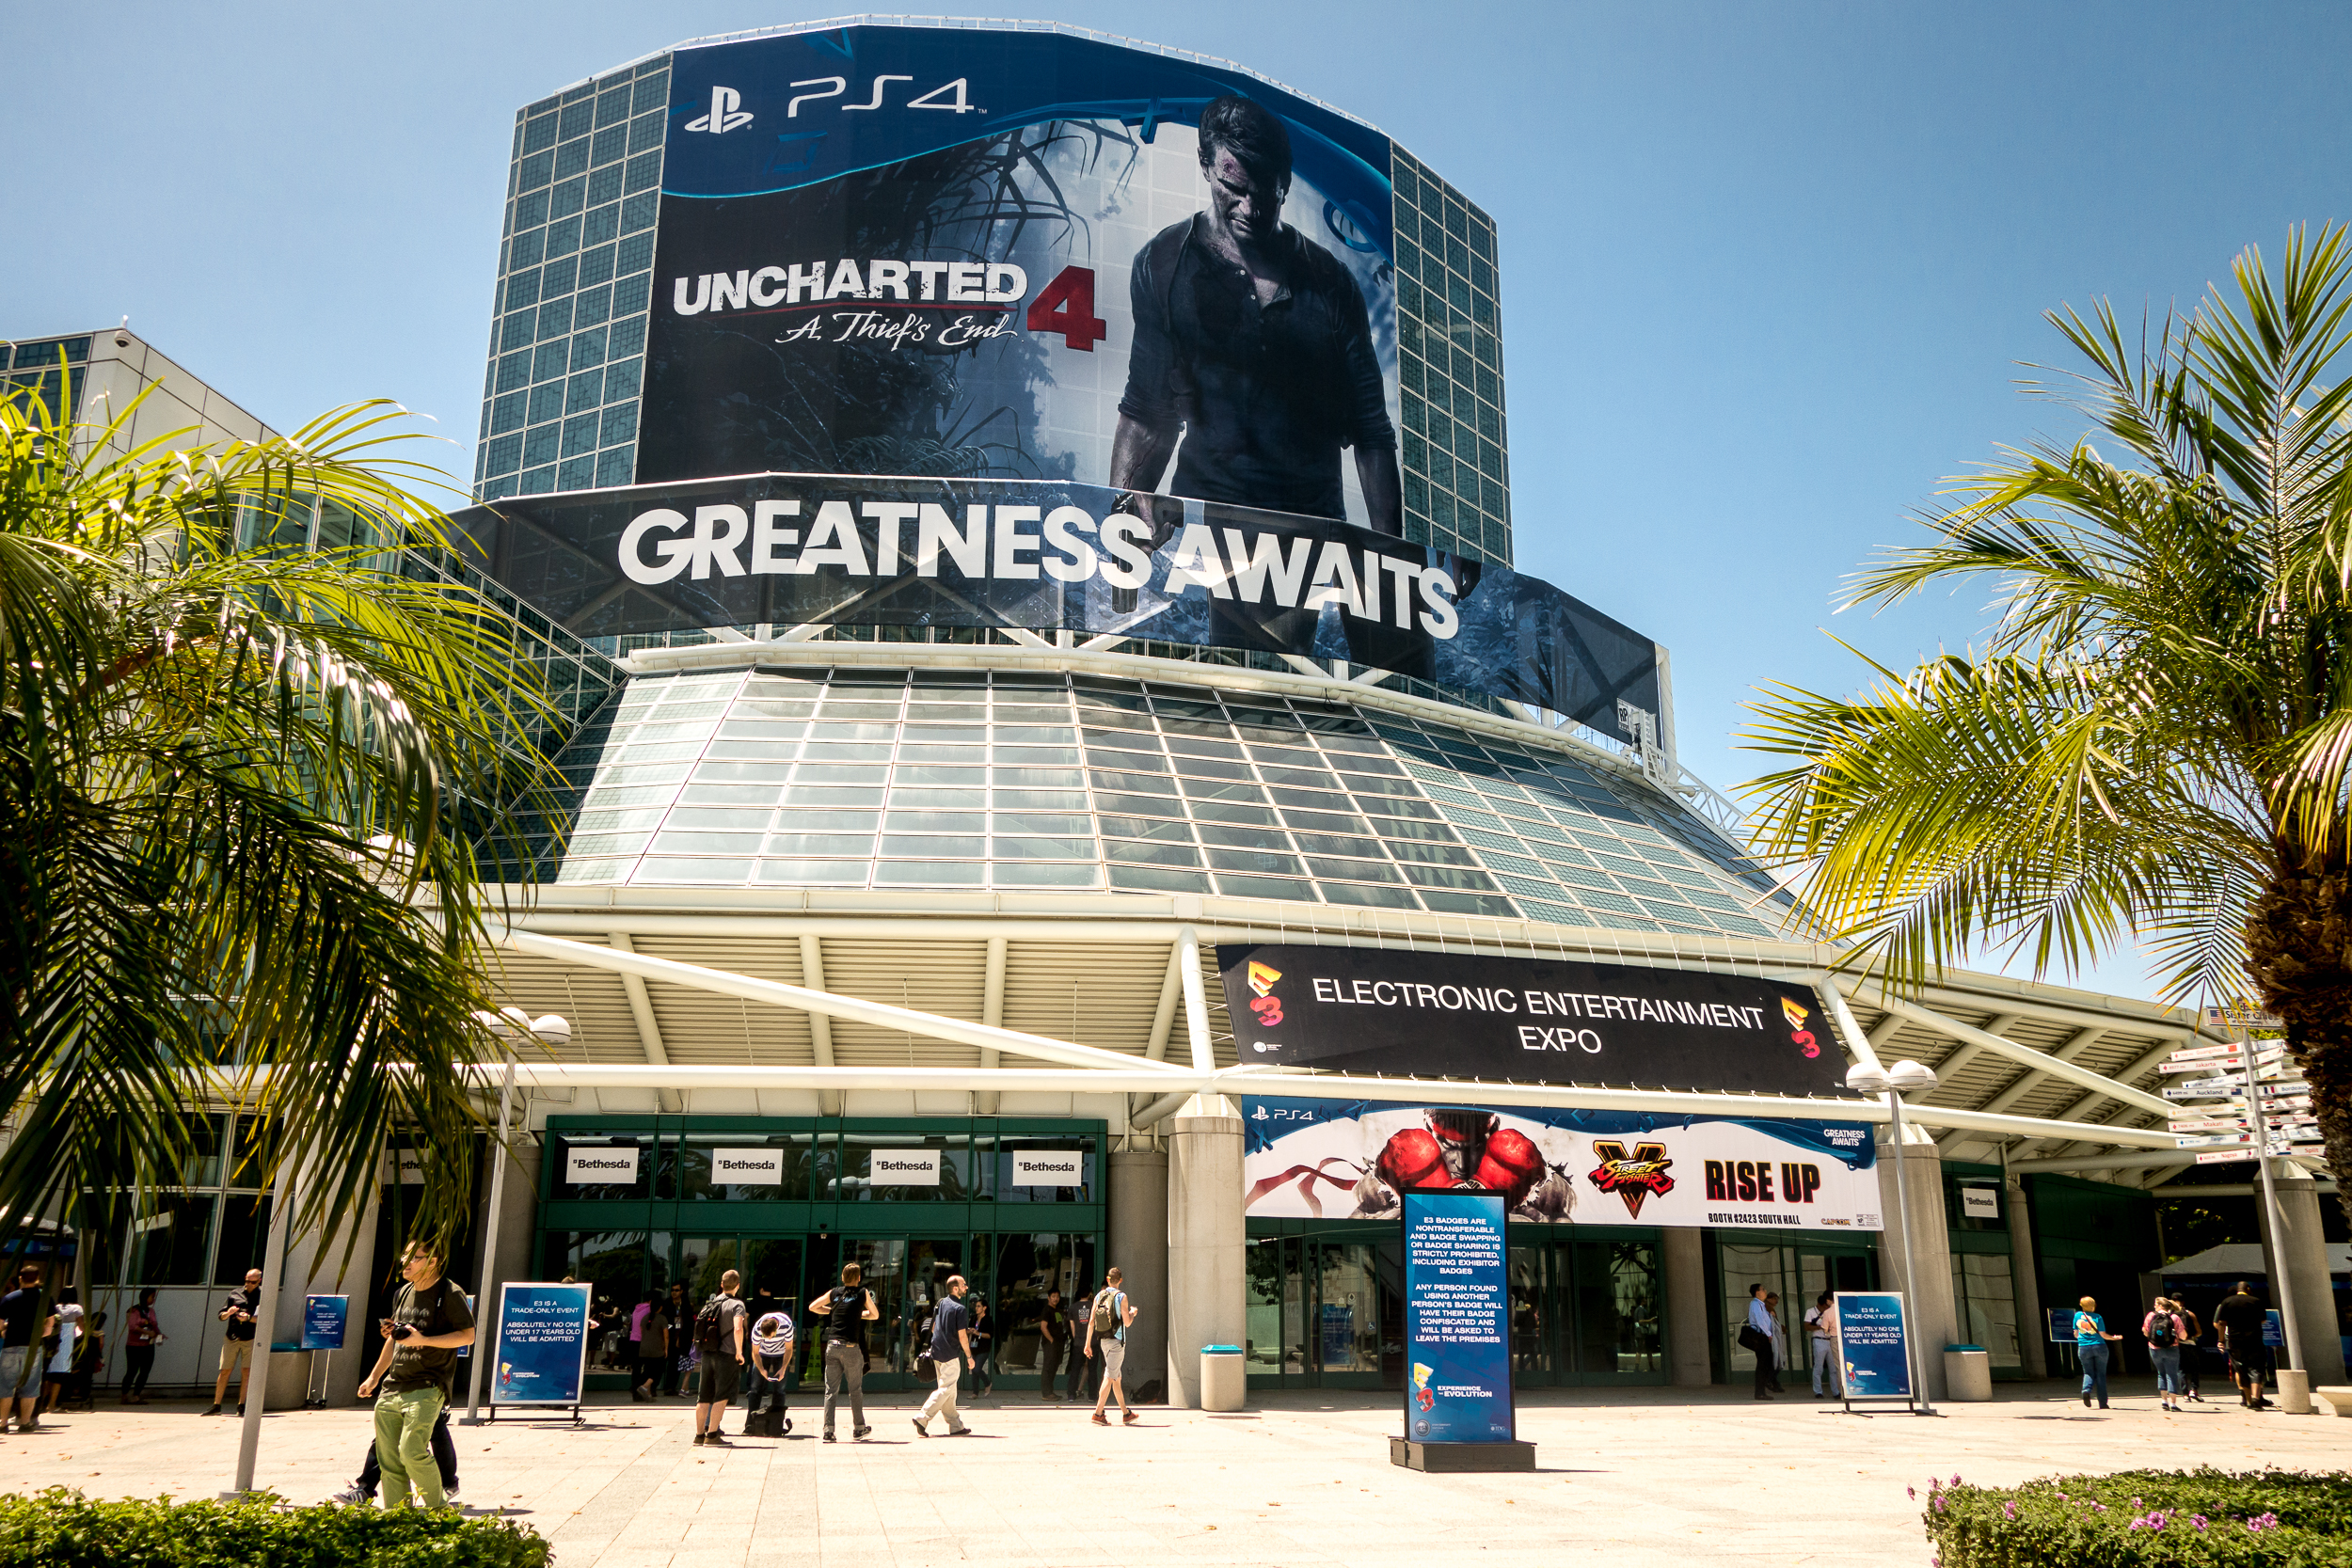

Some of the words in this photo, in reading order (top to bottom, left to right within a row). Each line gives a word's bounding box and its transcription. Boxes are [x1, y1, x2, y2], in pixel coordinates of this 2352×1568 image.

[787, 74, 975, 118] PS4
[674, 259, 1028, 315] UNCHARTED
[1027, 265, 1106, 352] 4
[775, 318, 821, 343] A
[833, 311, 931, 352] Thief's
[937, 313, 1018, 346] End
[617, 499, 1152, 590] GREATNESS
[1163, 523, 1458, 640] AWAITS
[1248, 960, 1284, 1027] E3
[1312, 977, 1518, 1013] ELECTRONIC
[1524, 990, 1764, 1030] ENTERTAINMENT
[1780, 996, 1820, 1059] E3
[1518, 1025, 1602, 1053] EXPO
[1274, 1109, 1313, 1120] PS4
[1823, 1128, 1865, 1139] GREATNESS
[1832, 1137, 1859, 1146] AWAITS
[578, 1159, 631, 1169] Bethesda
[723, 1160, 775, 1170] Bethesda
[881, 1161, 933, 1171] Bethesda
[1023, 1162, 1075, 1172] Bethesda
[1590, 1159, 1670, 1180] STREET
[1601, 1172, 1673, 1194] FIGHTER
[1705, 1160, 1774, 1202] RISE
[1781, 1163, 1820, 1204] UP
[1968, 1196, 1994, 1206] Bethesda
[1708, 1212, 1733, 1223] BOOTH
[1734, 1213, 1756, 1224] #2423
[1757, 1214, 1783, 1225] SOUTH
[1784, 1215, 1801, 1225] HALL
[1413, 1362, 1436, 1412] E3
